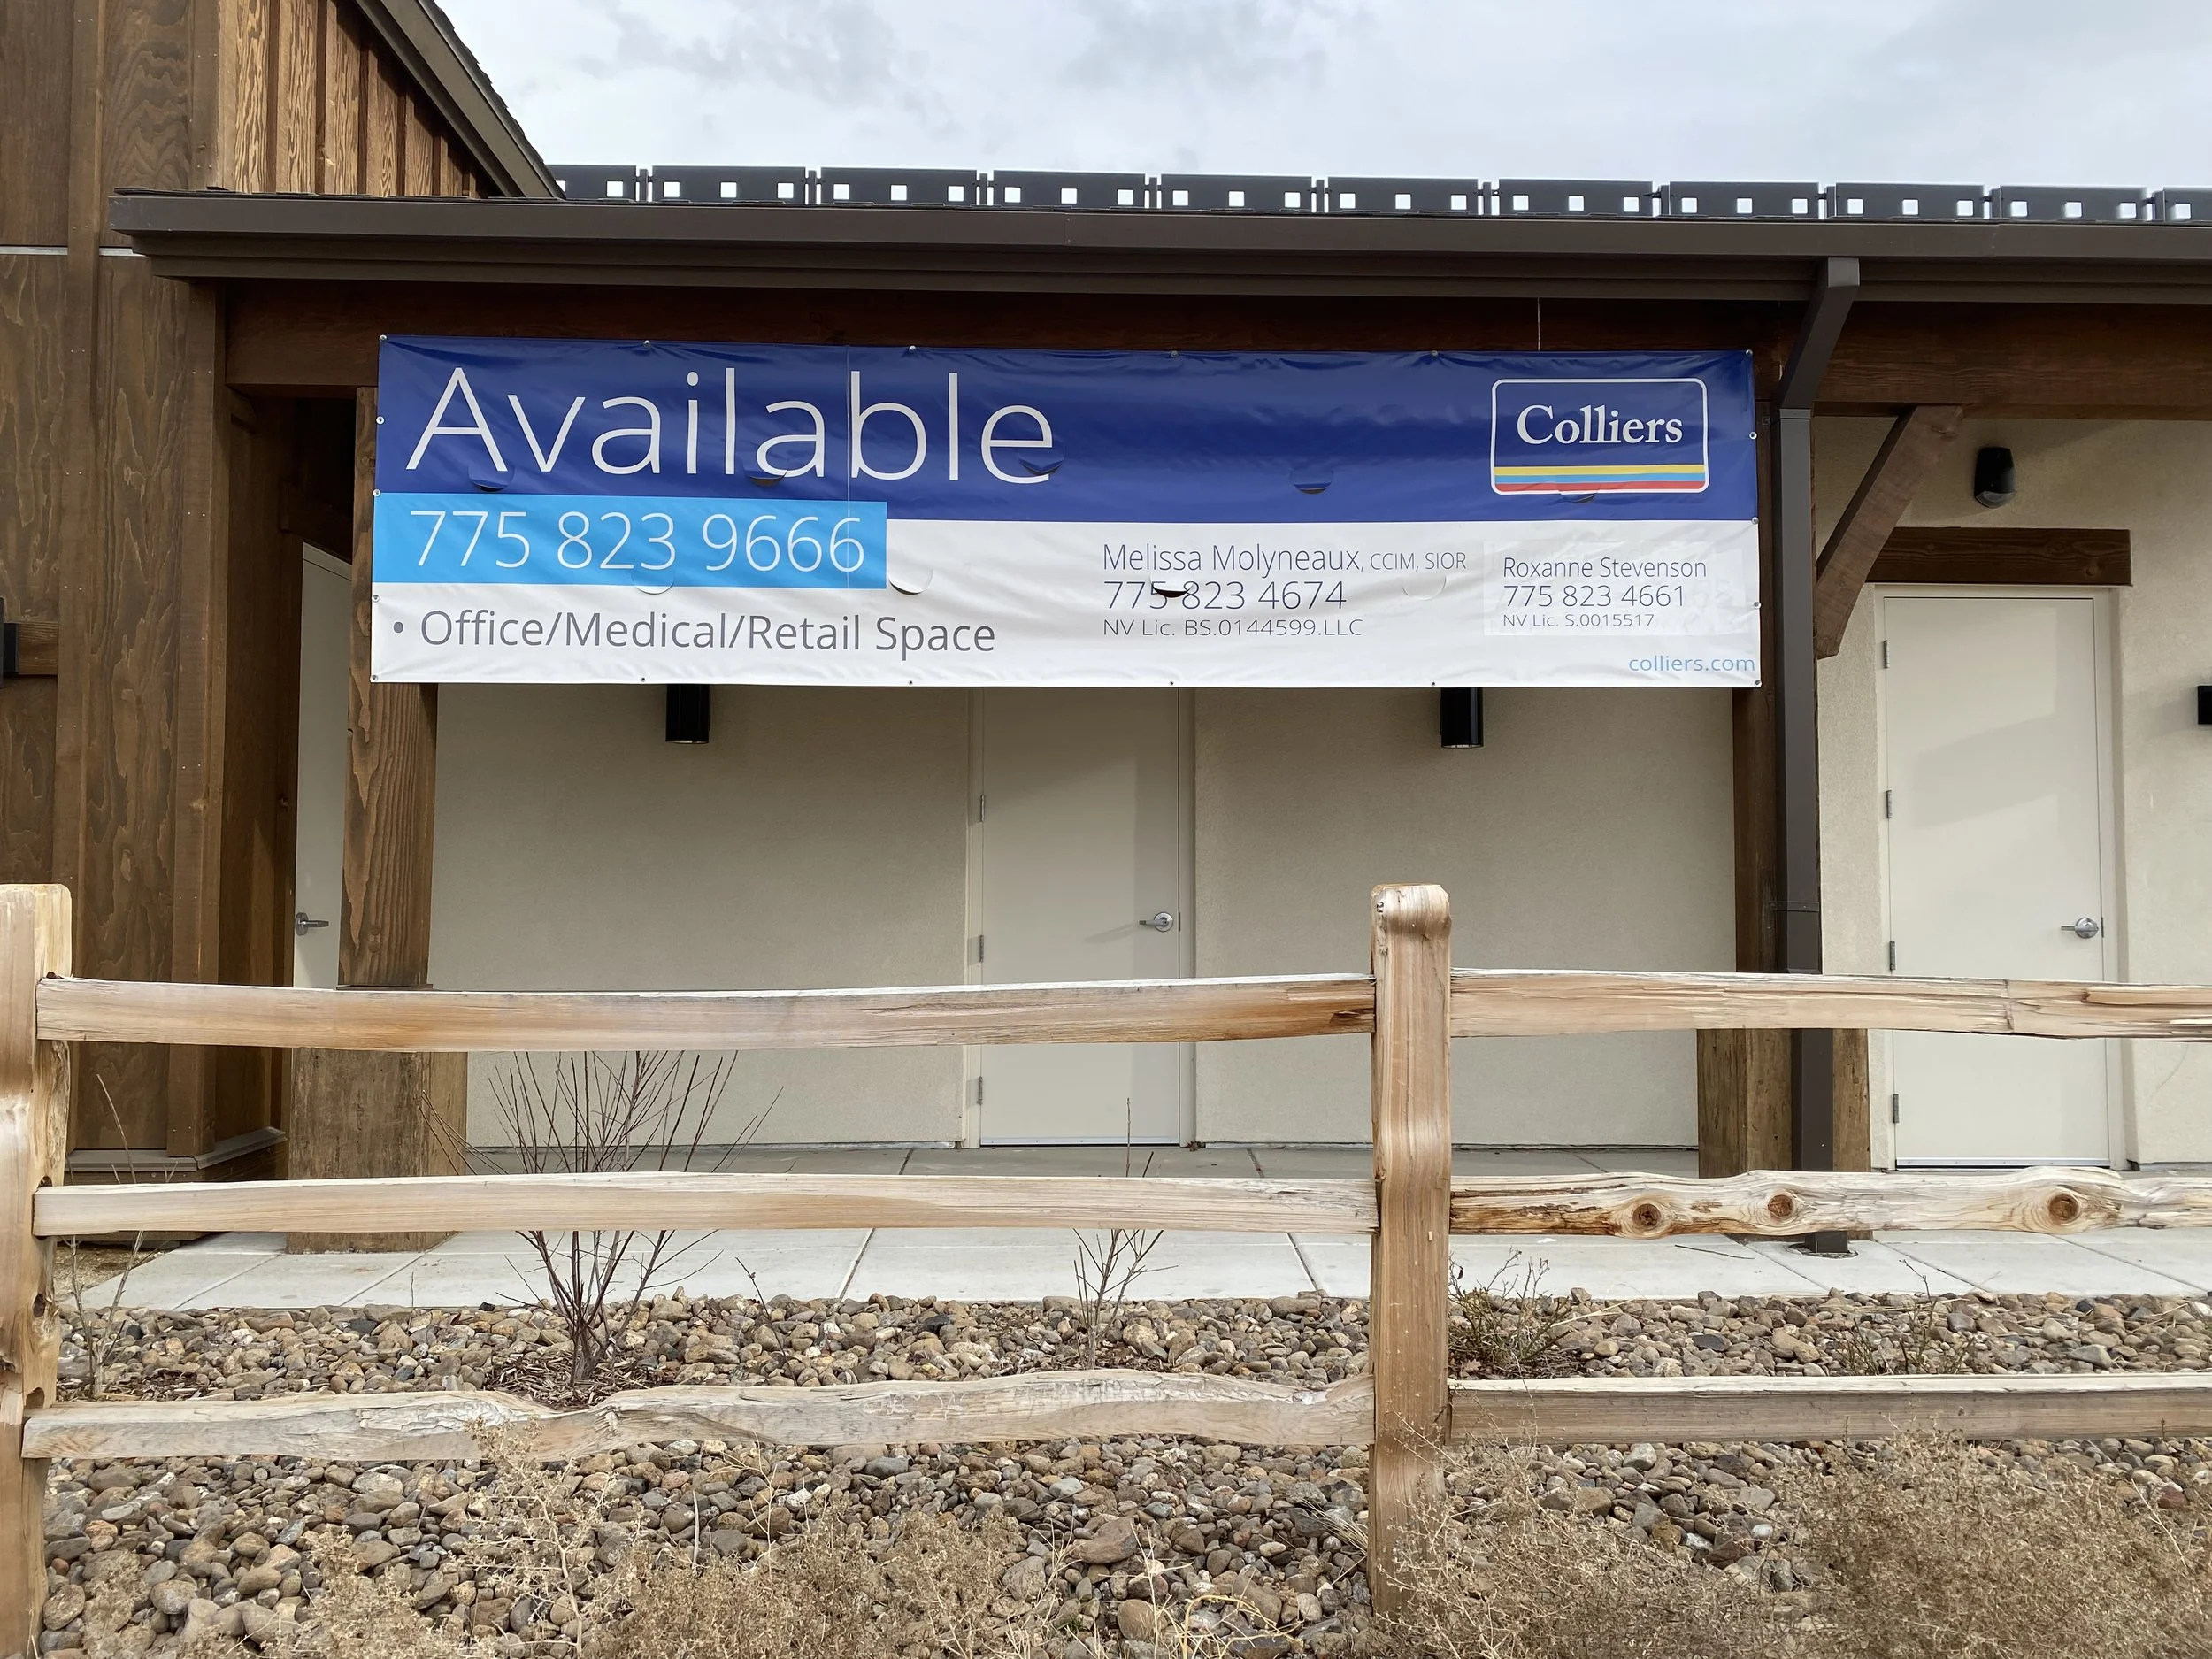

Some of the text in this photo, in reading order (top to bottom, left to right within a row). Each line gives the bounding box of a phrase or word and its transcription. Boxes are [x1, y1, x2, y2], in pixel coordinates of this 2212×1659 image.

[406, 366, 1054, 485] Available
[1517, 403, 1684, 445] Colliers
[409, 509, 865, 573] 775 823 9666
[1103, 543, 1467, 578] Melissa Molyneaux, CCIM, SIOR
[1503, 557, 1707, 578] Roxanne Stevenson
[1102, 580, 1348, 610] 775 823 4674
[1503, 585, 1685, 607] 775 823 4661
[1103, 618, 1363, 637] NV Lic. BS.0144599.LLC
[1503, 613, 1655, 626] NV Lic. S.0015517
[420, 610, 996, 661] Office/Medical/Retail Space
[1629, 655, 1755, 672] colliers.com
